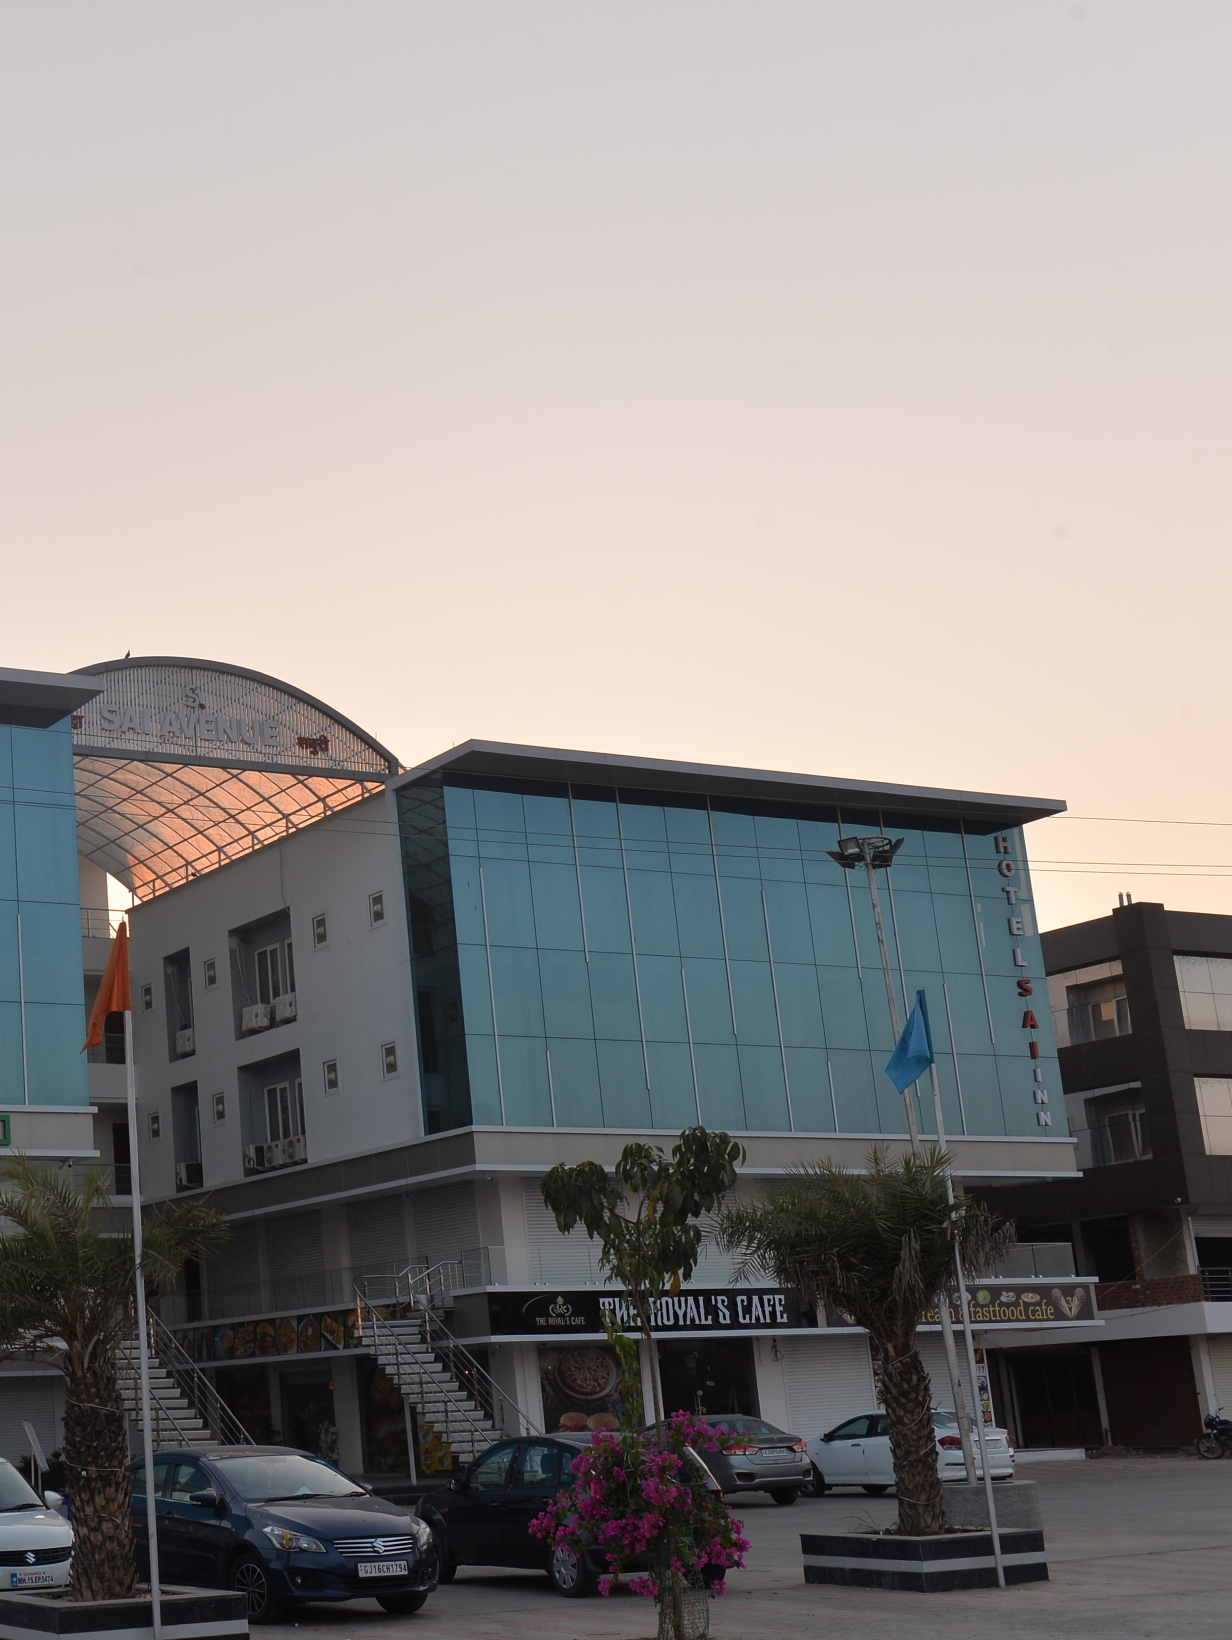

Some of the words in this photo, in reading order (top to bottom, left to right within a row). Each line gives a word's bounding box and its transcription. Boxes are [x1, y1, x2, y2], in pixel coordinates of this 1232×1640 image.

[101, 704, 151, 735] SAI
[161, 711, 280, 747] AVENUE
[994, 835, 1028, 967] HOTEL
[1017, 979, 1039, 1059] SAI
[1034, 1068, 1052, 1126] INN
[536, 1318, 547, 1326] THE
[548, 1317, 570, 1325] ROYAL'S
[571, 1317, 585, 1325] CAFE
[736, 1295, 788, 1323] CAFE
[969, 1300, 1026, 1321] fastfood
[1028, 1300, 1055, 1320] cafe
